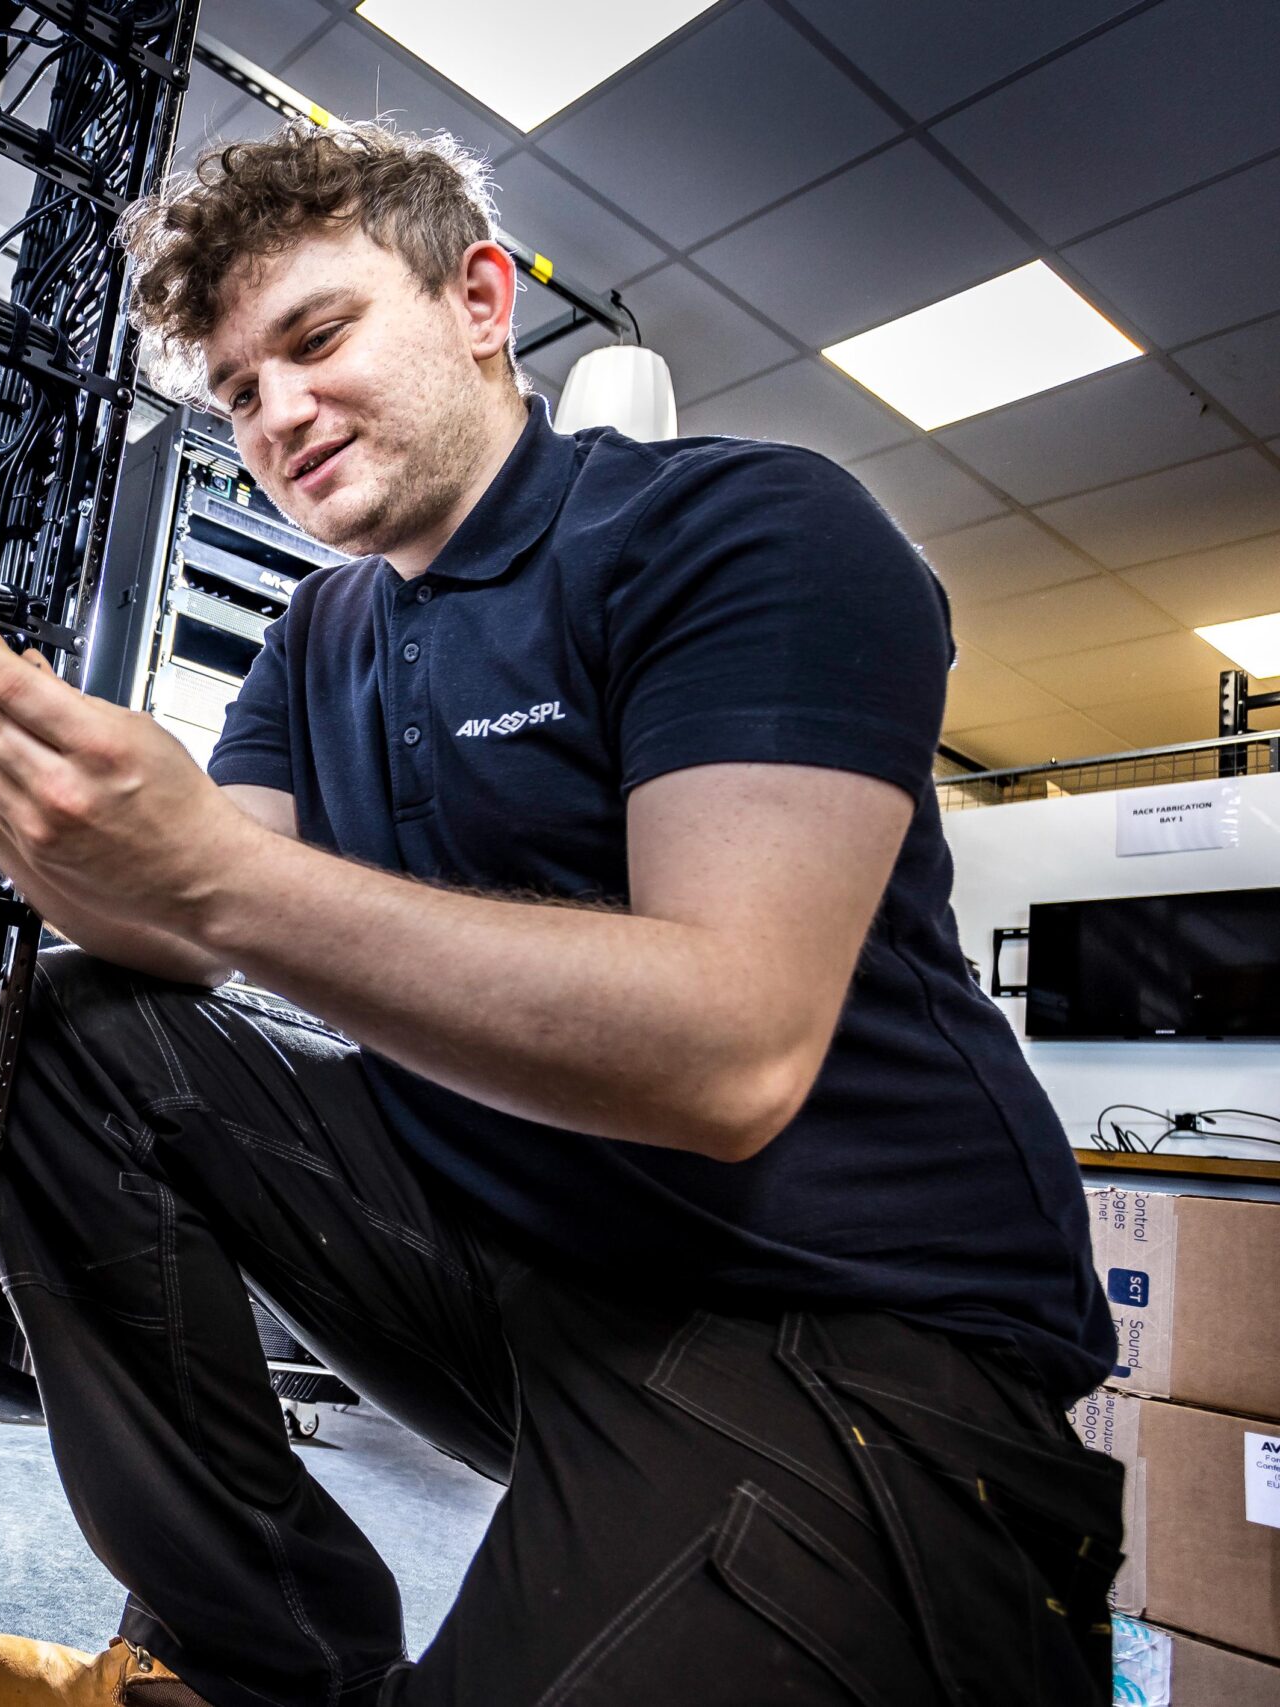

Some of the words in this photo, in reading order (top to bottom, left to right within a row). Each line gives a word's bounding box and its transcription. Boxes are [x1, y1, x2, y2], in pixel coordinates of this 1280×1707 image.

[528, 701, 566, 724] SPL
[1132, 808, 1154, 816] RACK
[1156, 801, 1213, 813] FABRICATION
[1159, 816, 1177, 824] BAY
[1129, 1276, 1142, 1303] SCT
[1128, 1320, 1144, 1368] Sound
